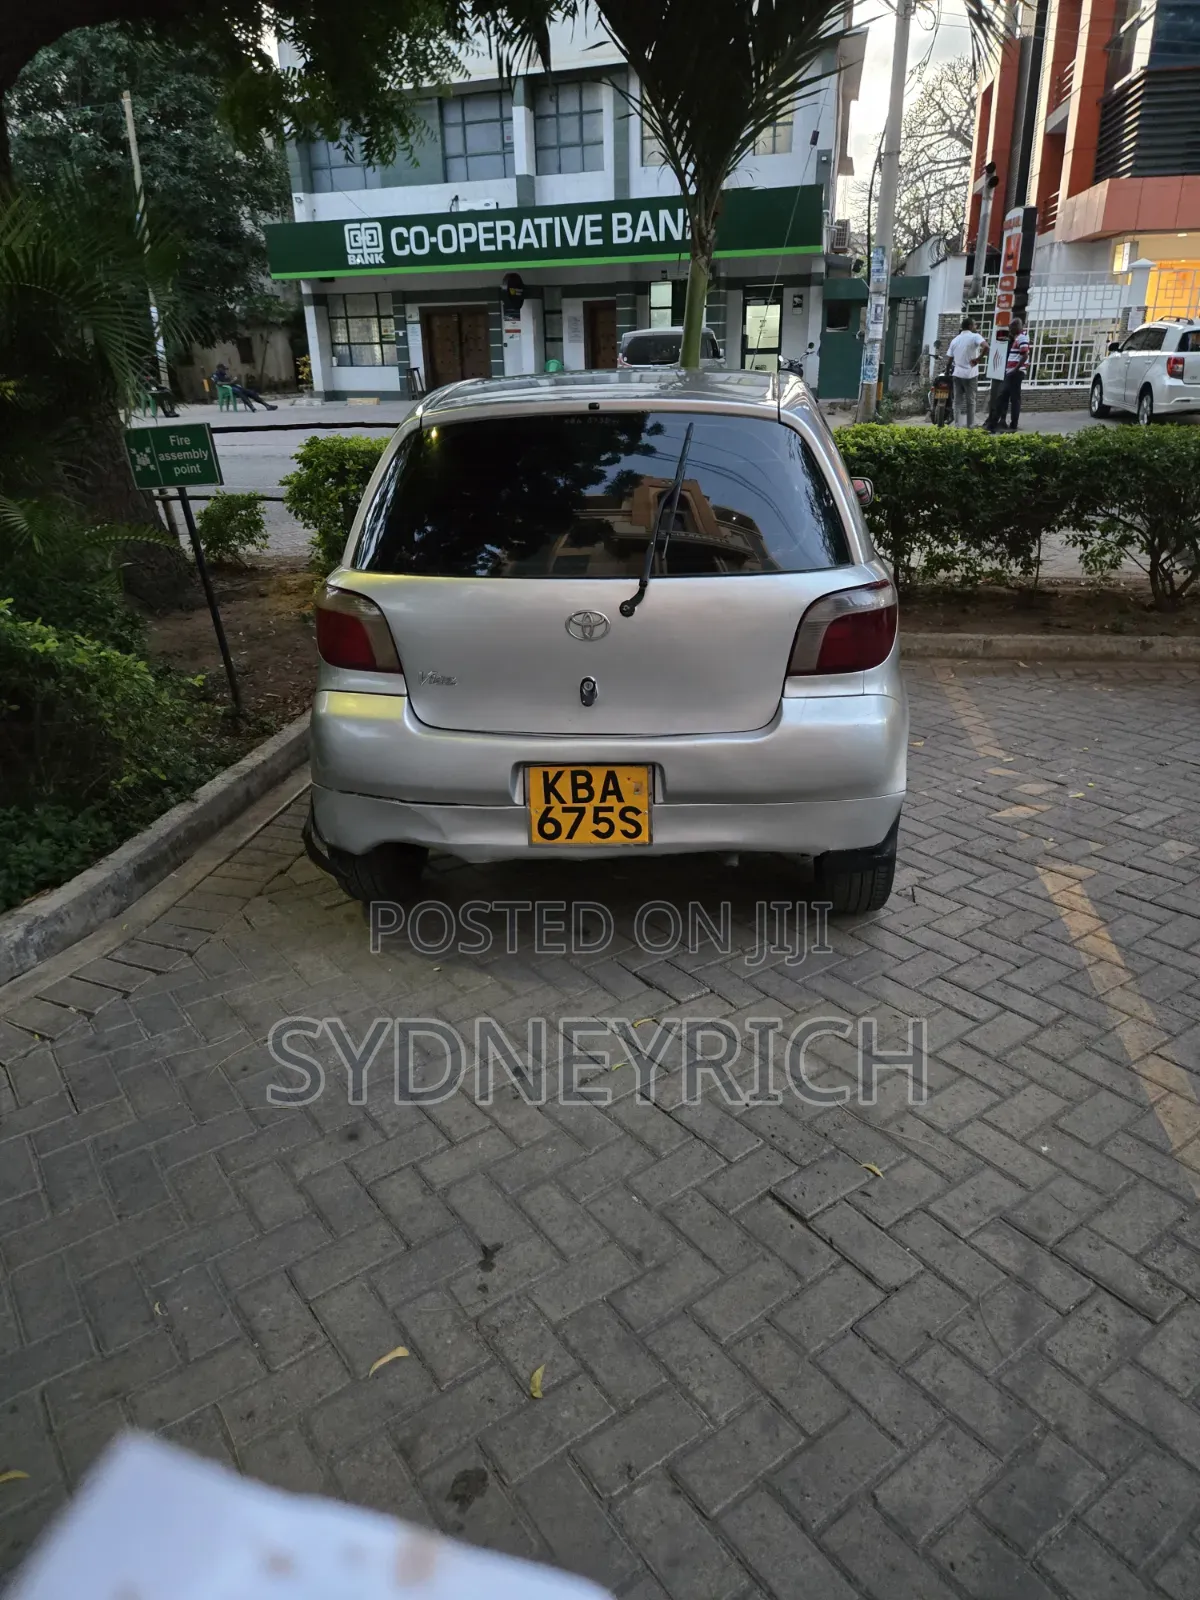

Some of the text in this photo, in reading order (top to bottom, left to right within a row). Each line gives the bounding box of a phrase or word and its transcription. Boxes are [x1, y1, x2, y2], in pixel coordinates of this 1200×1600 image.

[389, 213, 604, 256] CO-OPERATIVE
[347, 252, 386, 265] BANK
[169, 435, 191, 446] Fire
[158, 448, 208, 461] assembly
[173, 464, 202, 477] point
[541, 769, 625, 805] KBA
[536, 805, 643, 840] 675S
